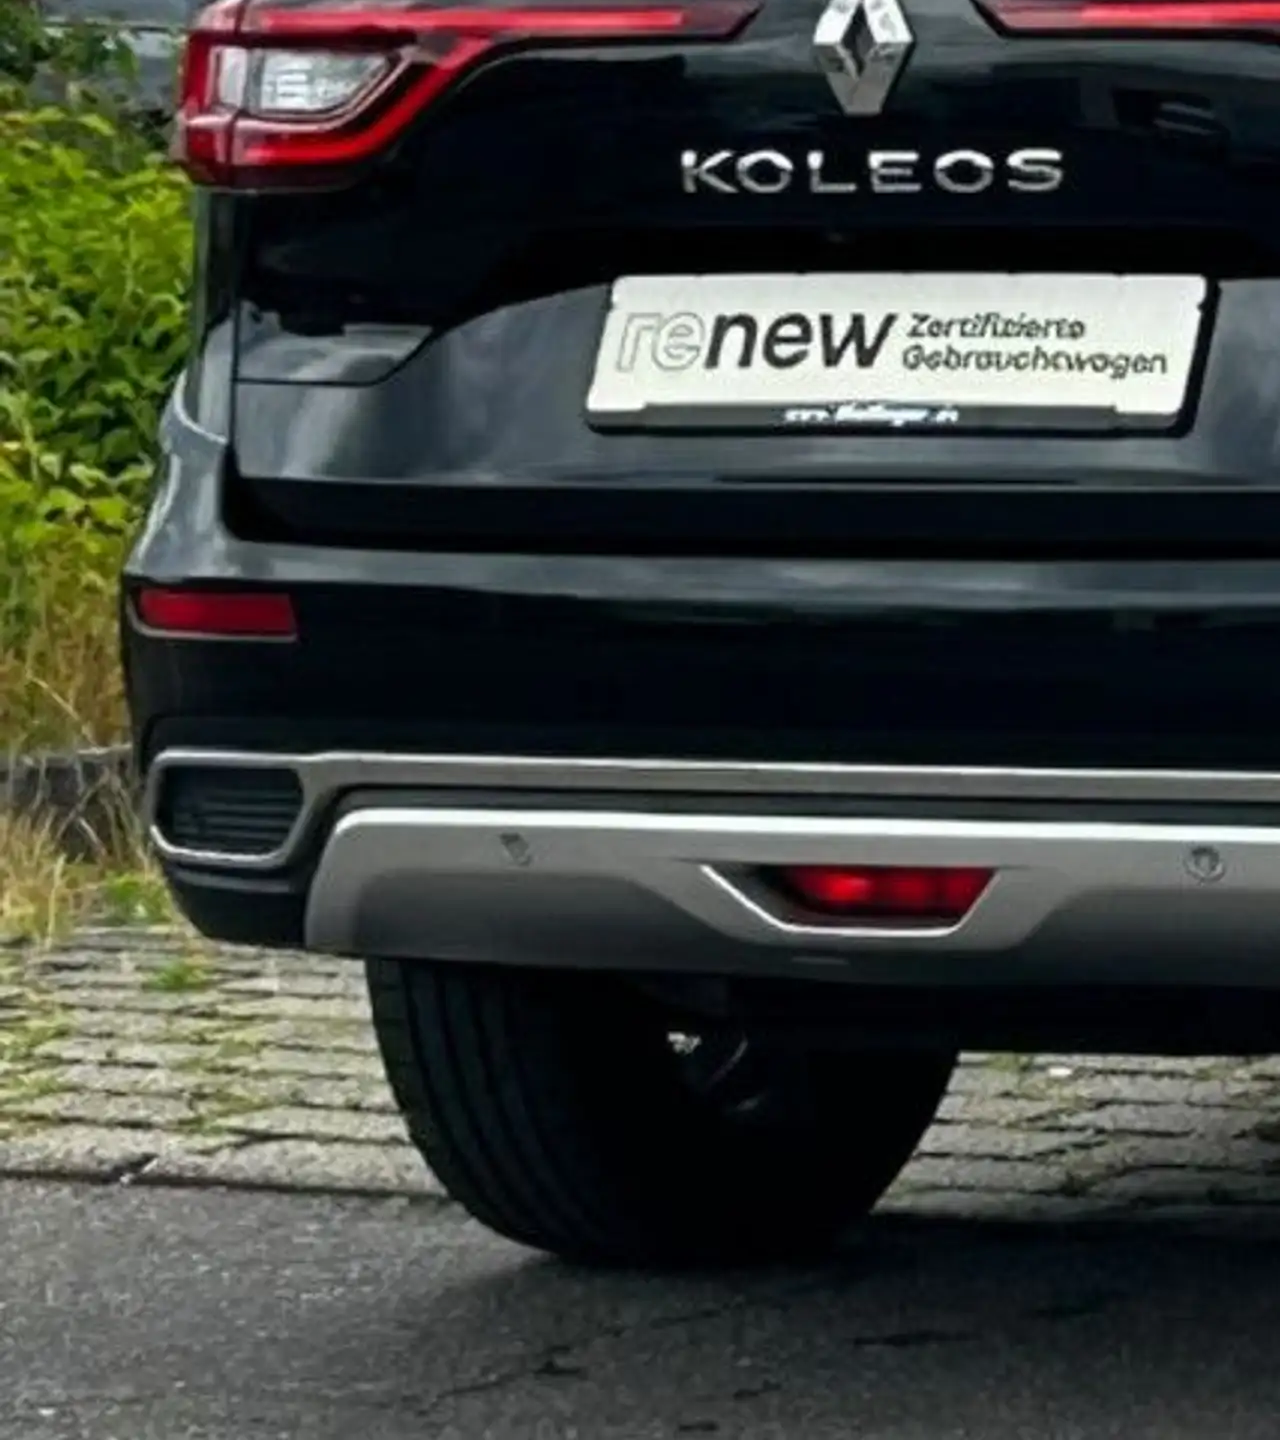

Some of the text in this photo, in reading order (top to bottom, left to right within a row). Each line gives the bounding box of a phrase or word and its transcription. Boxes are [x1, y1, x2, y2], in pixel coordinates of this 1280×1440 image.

[680, 149, 1064, 194] KOLEOS
[616, 311, 898, 372] renew
[902, 344, 1167, 379] Gebrauchtwagen
